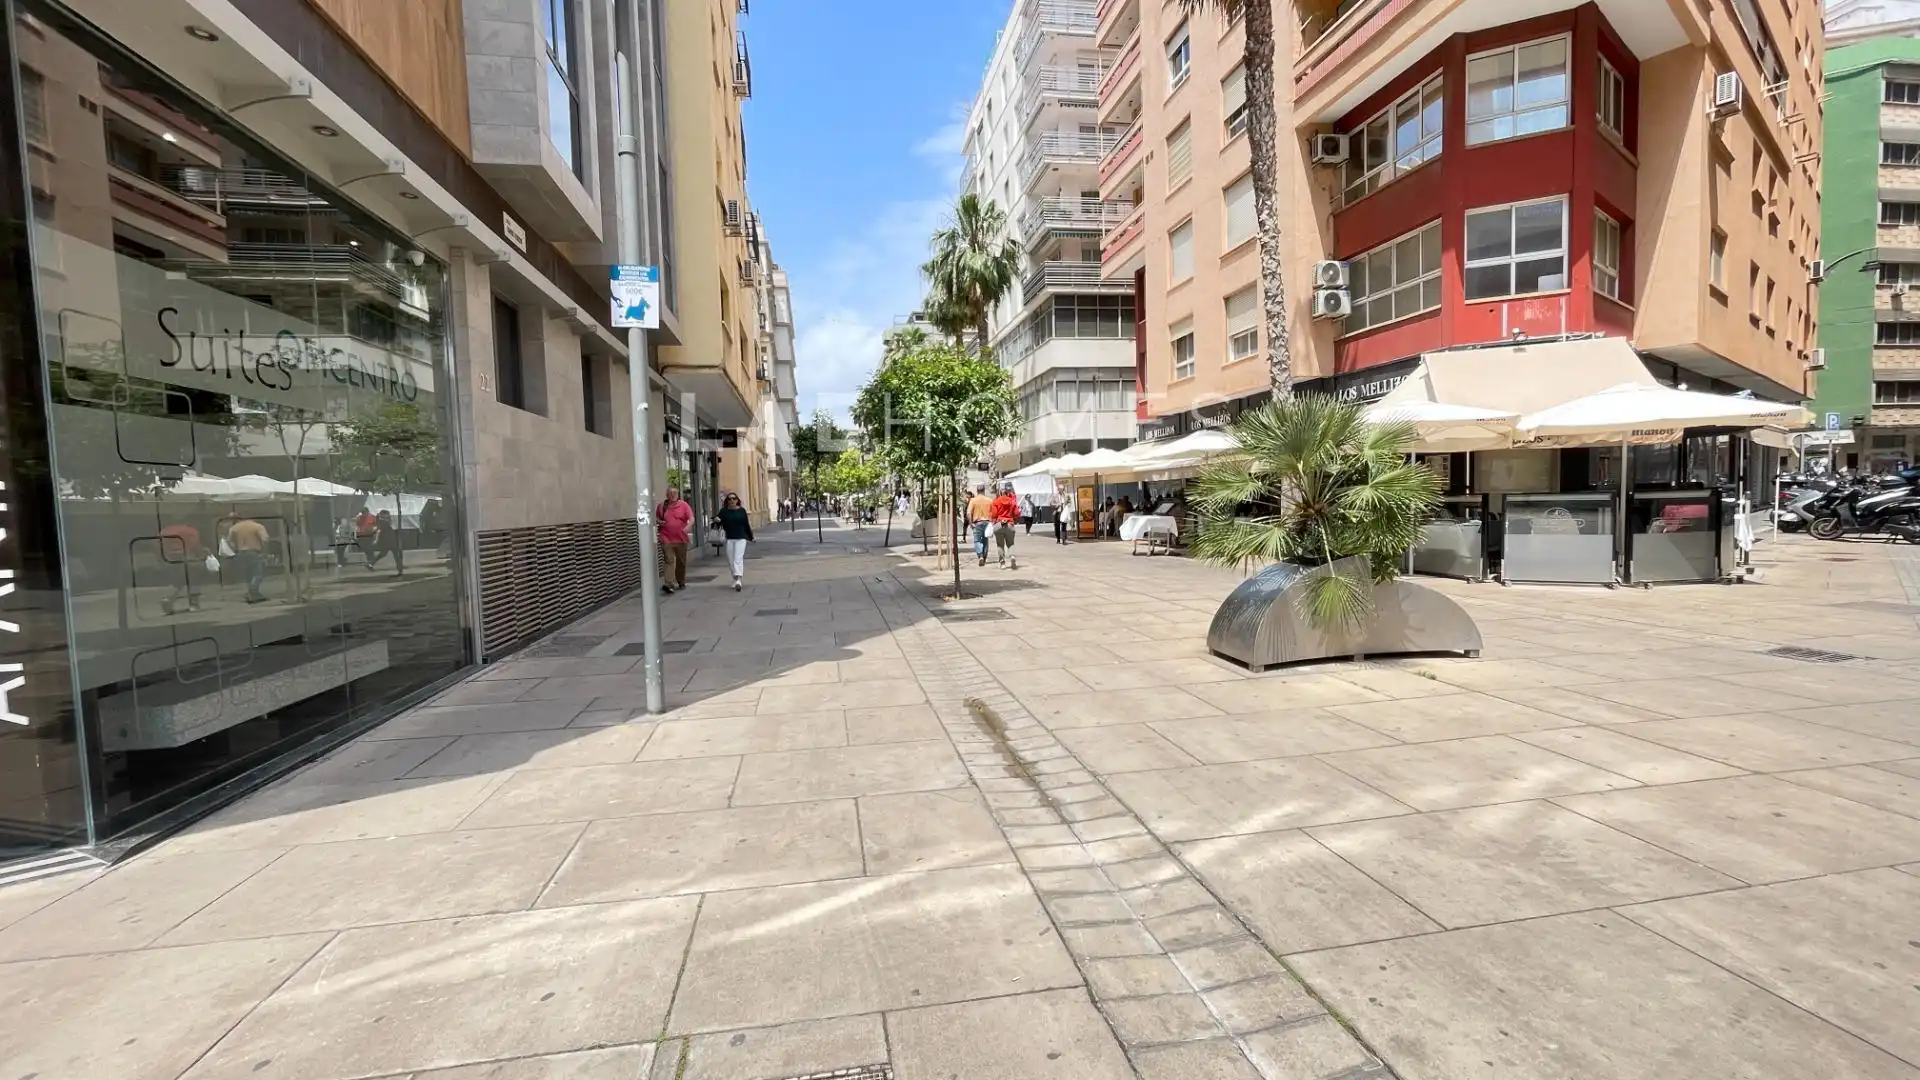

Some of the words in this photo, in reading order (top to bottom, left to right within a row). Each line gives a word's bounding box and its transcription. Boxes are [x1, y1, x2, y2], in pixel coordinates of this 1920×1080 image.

[158, 307, 293, 391] Suites
[479, 372, 491, 393] 22
[1339, 386, 1357, 401] LOS
[1829, 413, 1839, 429] P
